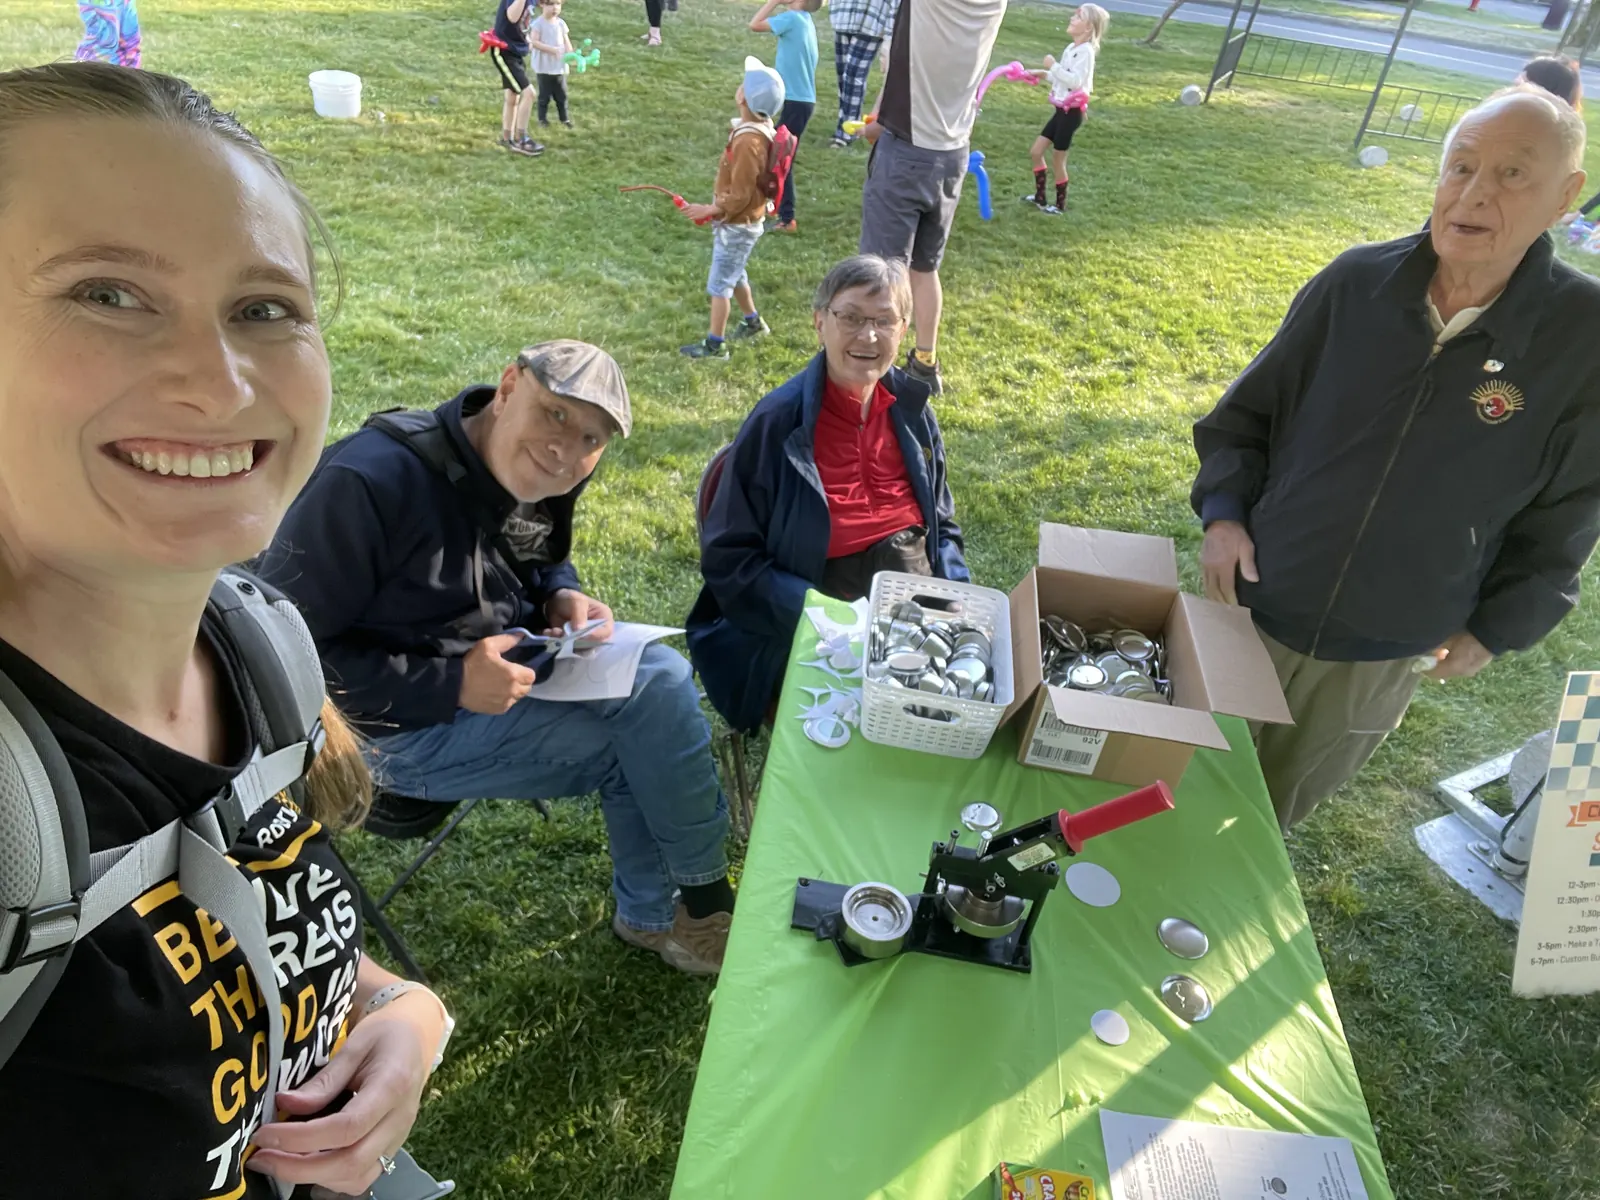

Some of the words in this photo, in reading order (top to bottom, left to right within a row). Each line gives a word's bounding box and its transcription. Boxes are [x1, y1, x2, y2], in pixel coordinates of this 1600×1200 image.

[1557, 896, 1589, 906] 12:30pm
[1568, 925, 1598, 934] 2:30pm
[1560, 955, 1589, 964] Custom
[190, 921, 336, 1050] THRE
[322, 890, 357, 949] IS
